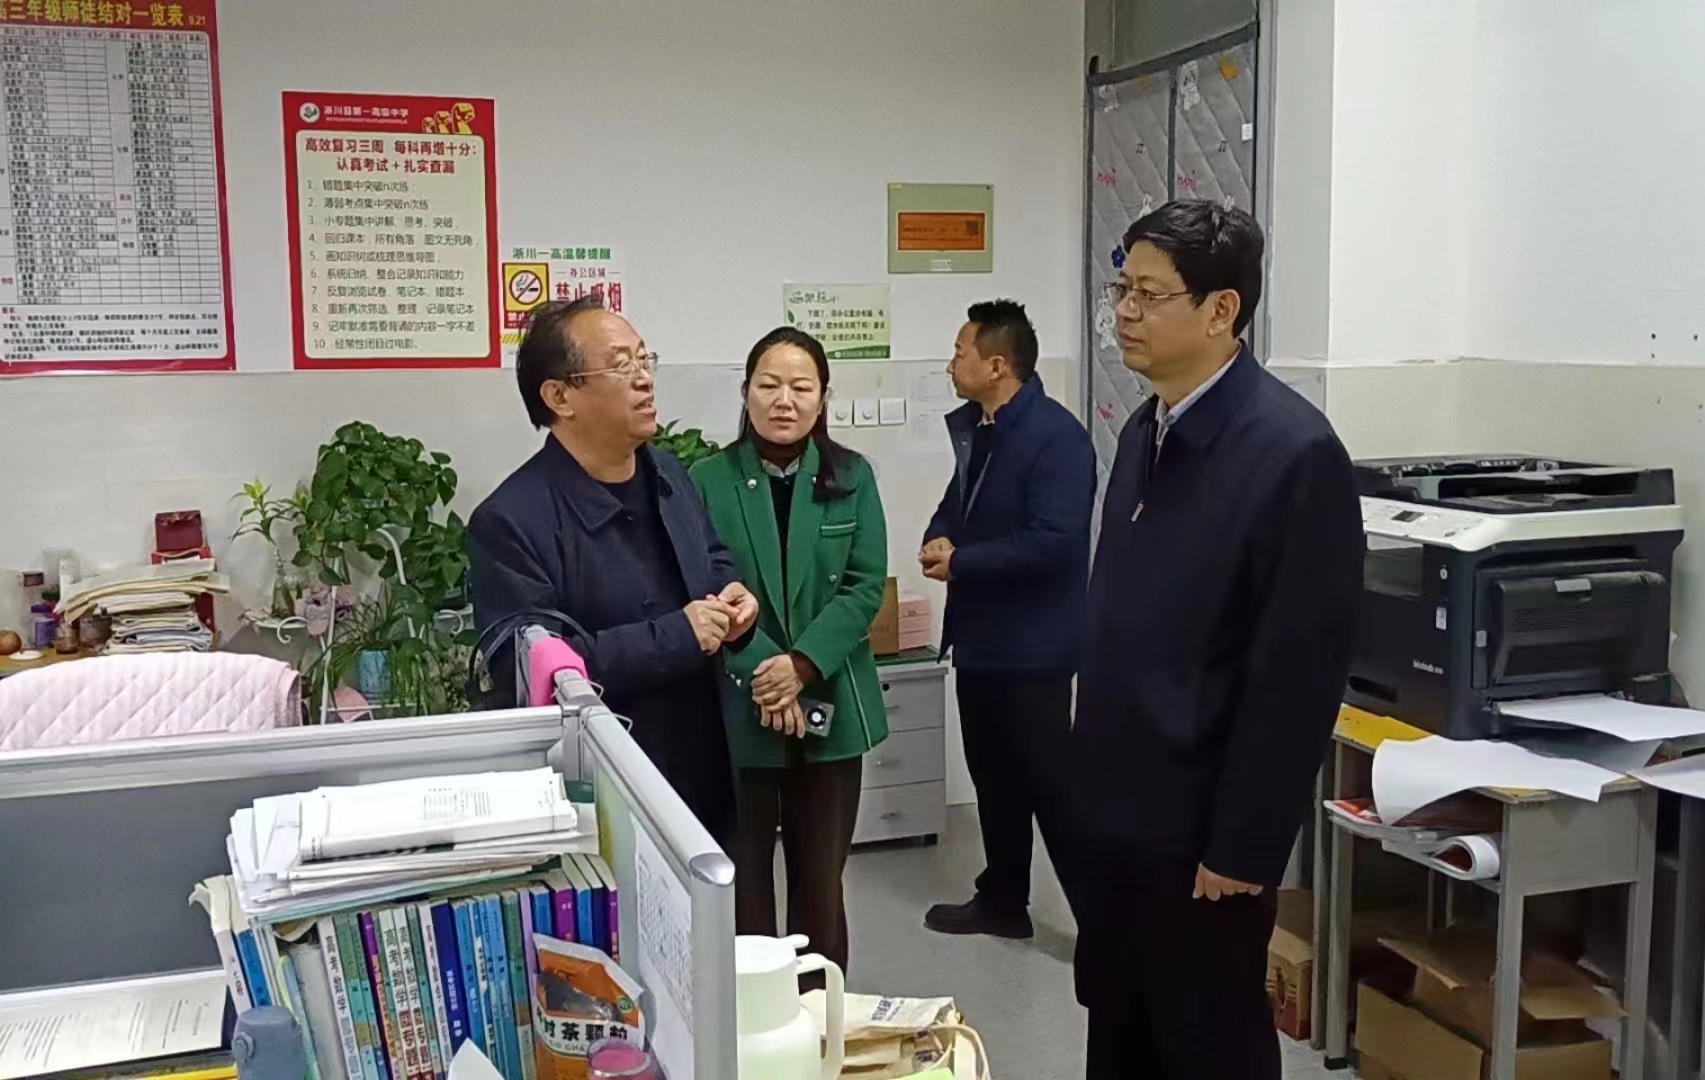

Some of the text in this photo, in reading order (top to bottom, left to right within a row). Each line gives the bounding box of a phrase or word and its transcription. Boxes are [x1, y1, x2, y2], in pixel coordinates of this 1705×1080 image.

[305, 137, 384, 153] 高效复习三周
[336, 157, 389, 172] 认真考试
[404, 158, 455, 174] 扎实查漏
[512, 247, 611, 260] 淅川一高温馨提醒
[569, 267, 608, 278] 办公区域
